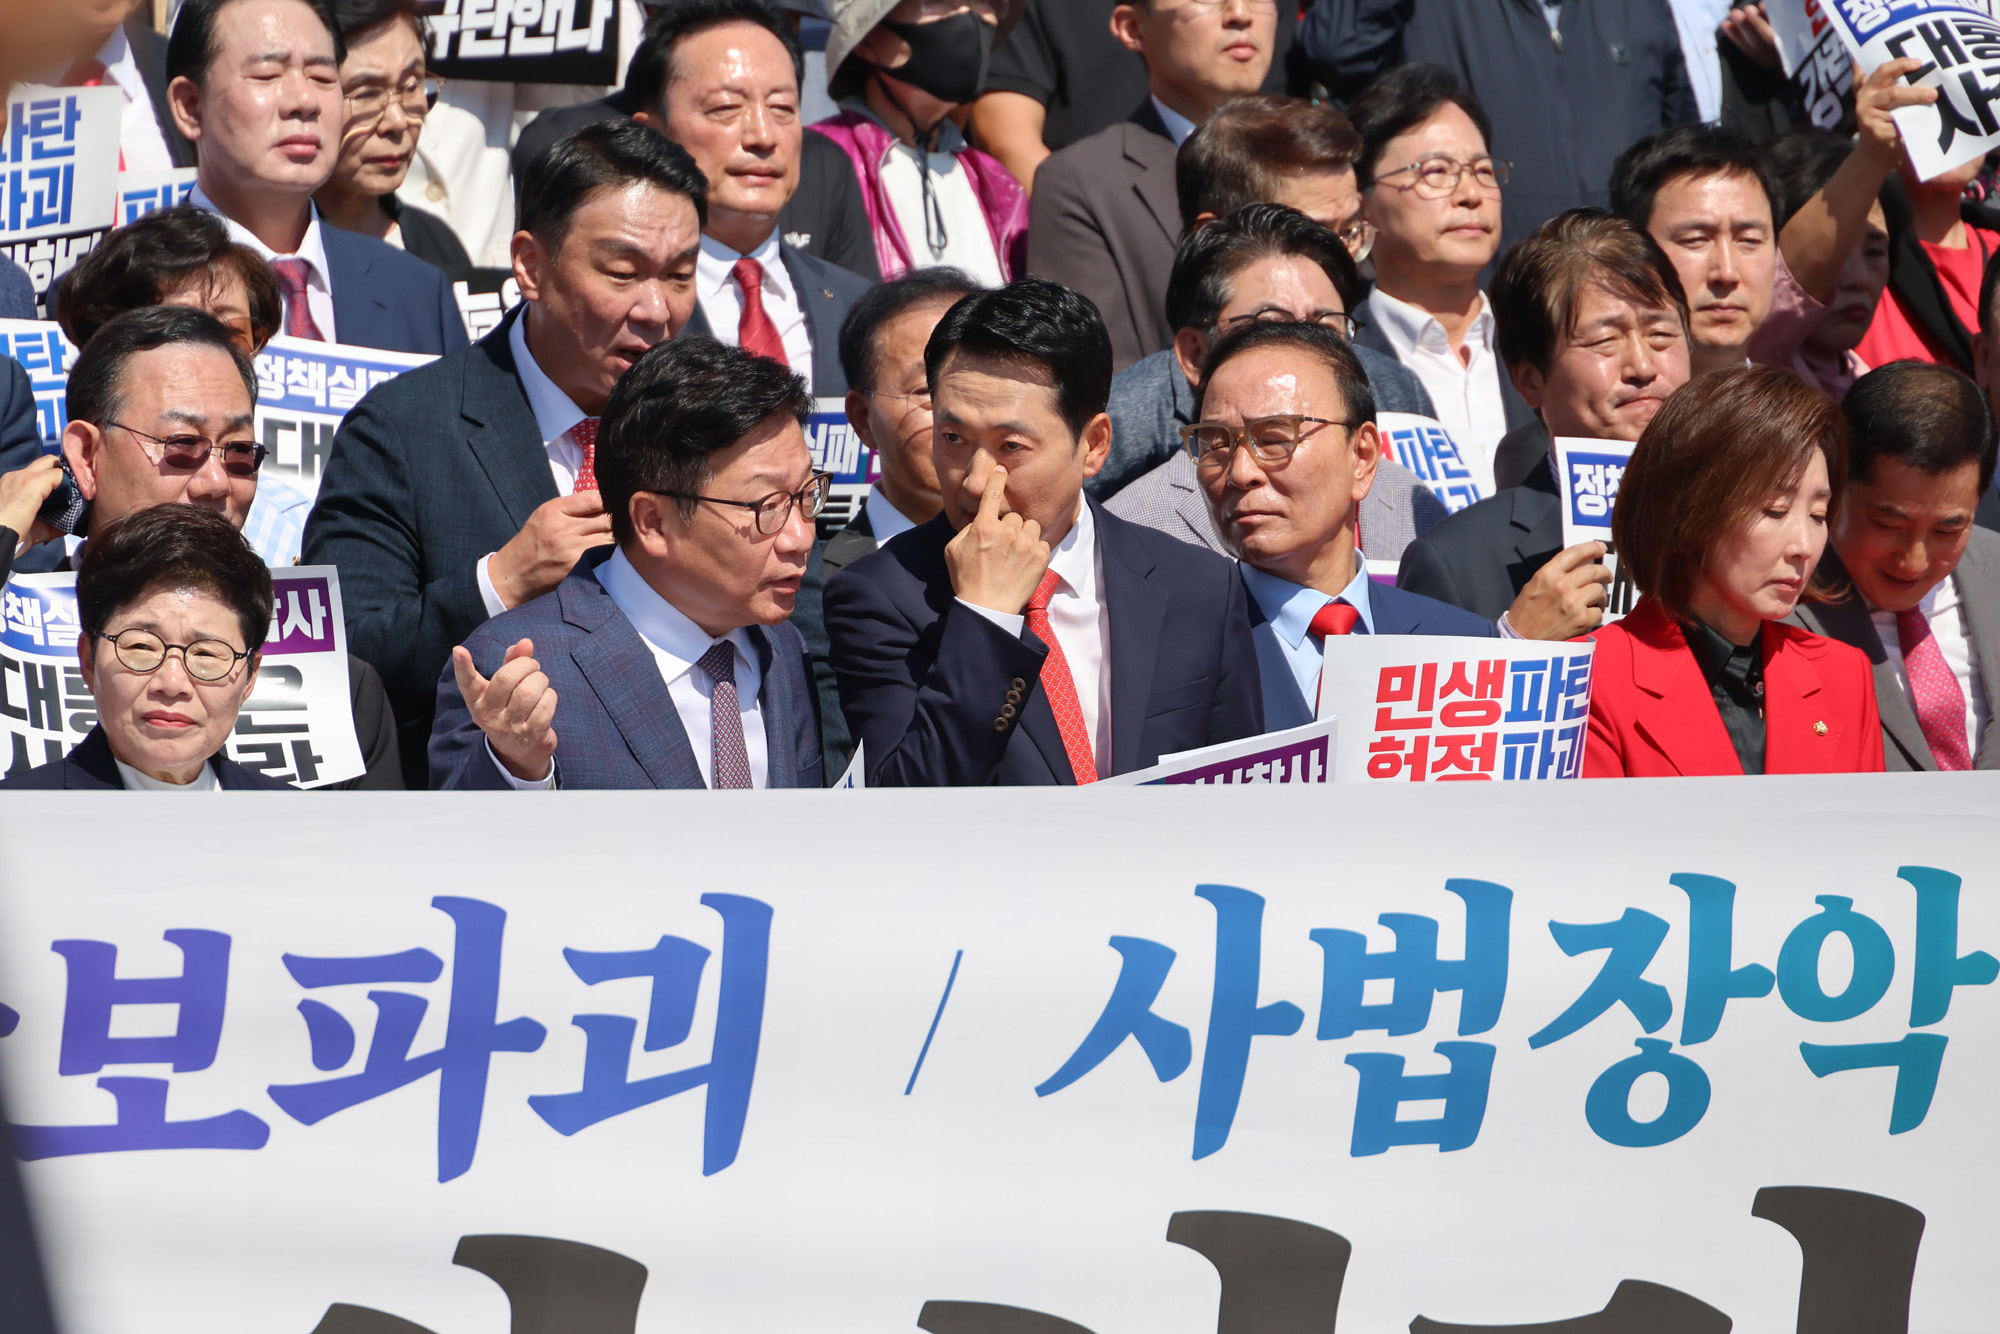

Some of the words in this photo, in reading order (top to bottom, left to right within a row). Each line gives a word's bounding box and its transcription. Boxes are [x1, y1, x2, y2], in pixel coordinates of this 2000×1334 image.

[1374, 653, 1595, 732] 민생파탄
[0, 892, 774, 1186] 보파괴
[1035, 865, 2000, 1162] 사법장악
